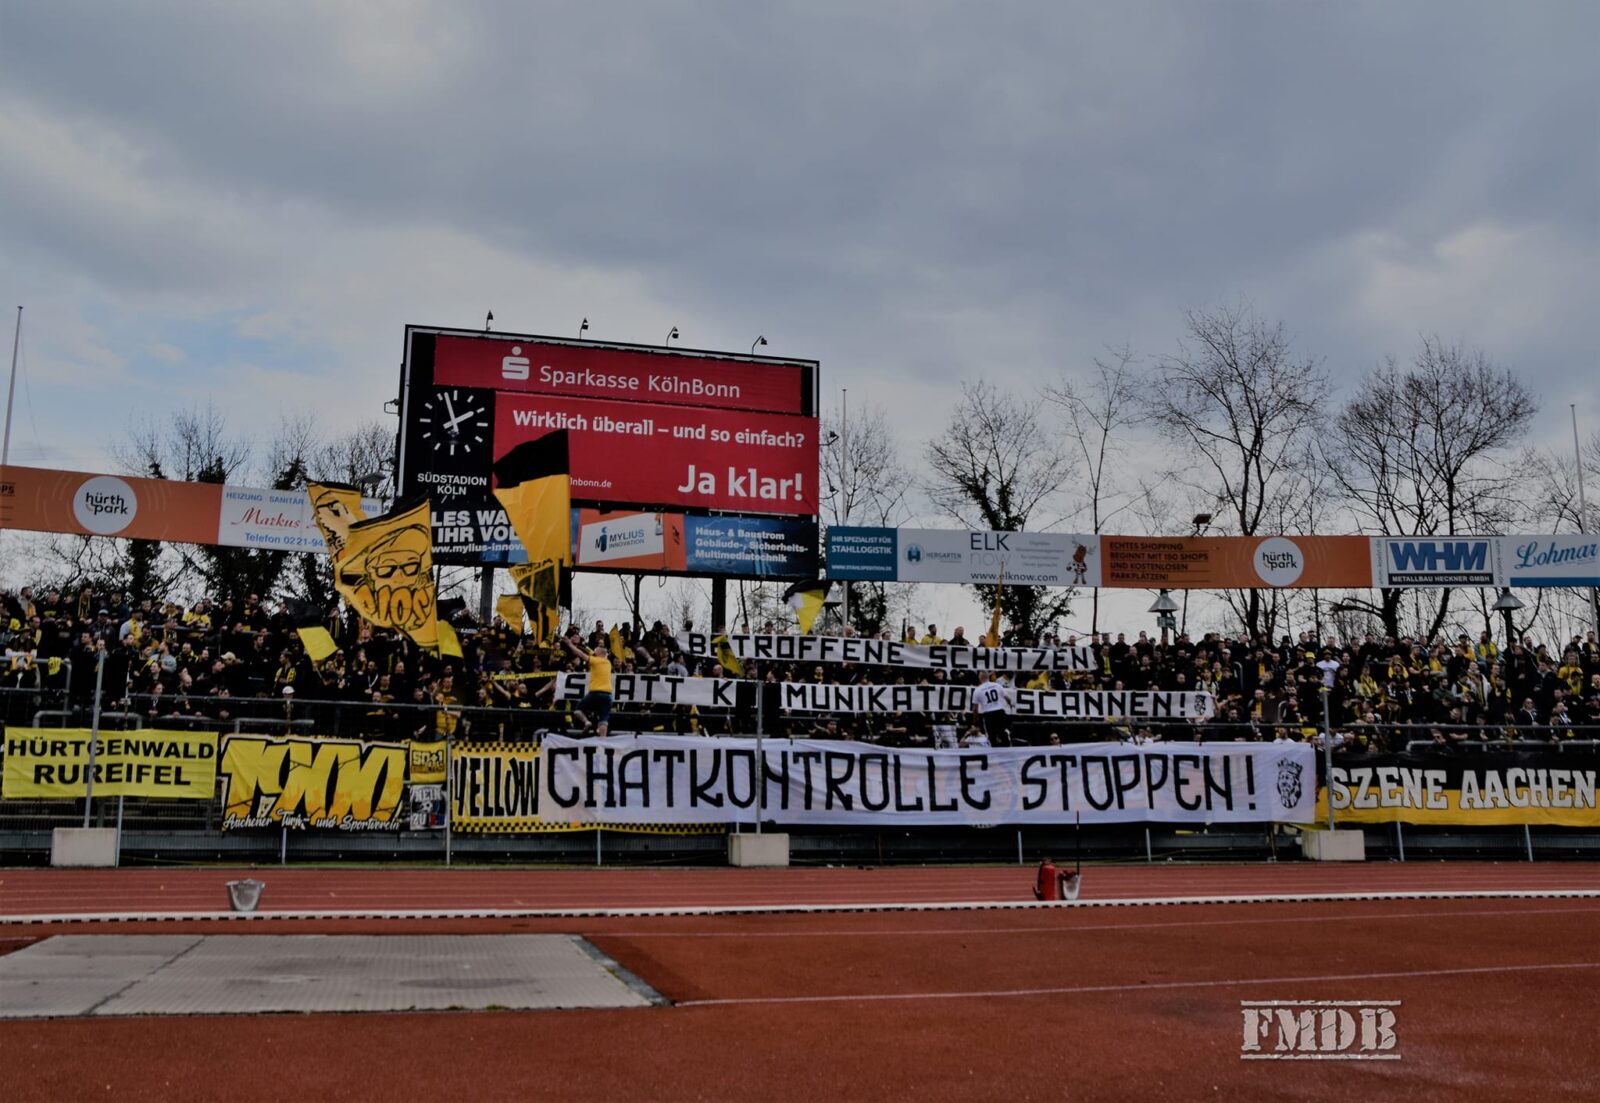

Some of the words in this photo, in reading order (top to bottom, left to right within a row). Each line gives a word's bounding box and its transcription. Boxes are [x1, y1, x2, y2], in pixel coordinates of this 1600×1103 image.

[540, 365, 640, 390] Sparkasse
[649, 375, 741, 398] KölnBonn
[513, 410, 588, 431] Wirklich
[592, 416, 653, 436] überall
[673, 424, 706, 440] und
[710, 430, 730, 442] so
[735, 430, 805, 448] einfach?
[417, 471, 487, 486] SÜDSTADION
[570, 477, 612, 488] lnbonn.de
[678, 464, 715, 494] Ja
[728, 466, 803, 500] klar!
[226, 491, 263, 502] HEIZUNG
[437, 484, 467, 495] KÖLN
[85, 491, 124, 506] hürth
[92, 503, 128, 516] park
[230, 507, 301, 529] Markus
[431, 511, 471, 527] LES
[476, 510, 509, 526] WA
[245, 532, 281, 544] Telefon
[284, 535, 325, 548] 0221-94
[437, 527, 474, 543] IHR
[609, 529, 645, 543] MYLIUS
[695, 527, 725, 537] Haus-
[727, 528, 735, 537] &
[737, 529, 785, 540] Baustrom
[831, 535, 843, 543] IHR
[844, 536, 878, 544] SPEZIALIST
[878, 536, 892, 544] FÜR
[609, 538, 645, 549] INNOVATION
[749, 541, 809, 553] Sicherheits-
[970, 532, 1010, 551] ELK
[1110, 542, 1138, 550] ECHTES
[1140, 543, 1184, 551] SHOPPING
[695, 549, 788, 562] Multimediatechnik
[831, 545, 892, 555] STAHLLOGISTIK
[1110, 552, 1145, 560] BEGINNT
[1147, 552, 1162, 560] MIT
[1180, 552, 1208, 560] SHOPS
[1262, 551, 1293, 562] hürth
[1389, 542, 1488, 570] WHM
[970, 553, 1010, 566] now
[1110, 562, 1128, 570] UND
[1130, 562, 1188, 571] KOSTENLOSEN
[1268, 560, 1298, 571] park
[1391, 575, 1434, 583] METALLBAU
[1435, 575, 1468, 583] HECKNER
[1468, 575, 1490, 583] GMBH
[929, 648, 1090, 671] SCHÜTZEN
[564, 674, 684, 702] SATT
[1016, 690, 1186, 717] SCANNEN!
[985, 689, 999, 704] 10
[8, 737, 214, 759] HÜRTGENWALD
[33, 763, 191, 786] RUREIFEL
[548, 746, 991, 811] CHATKONTROLLE
[1021, 754, 1256, 811] STOPPEN!
[454, 756, 540, 817] YELLOW
[1331, 766, 1448, 810] SZENE
[1459, 767, 1596, 810] AACHEN
[222, 812, 273, 830] Aachener
[316, 816, 336, 829] und
[339, 816, 400, 832] Sportverein
